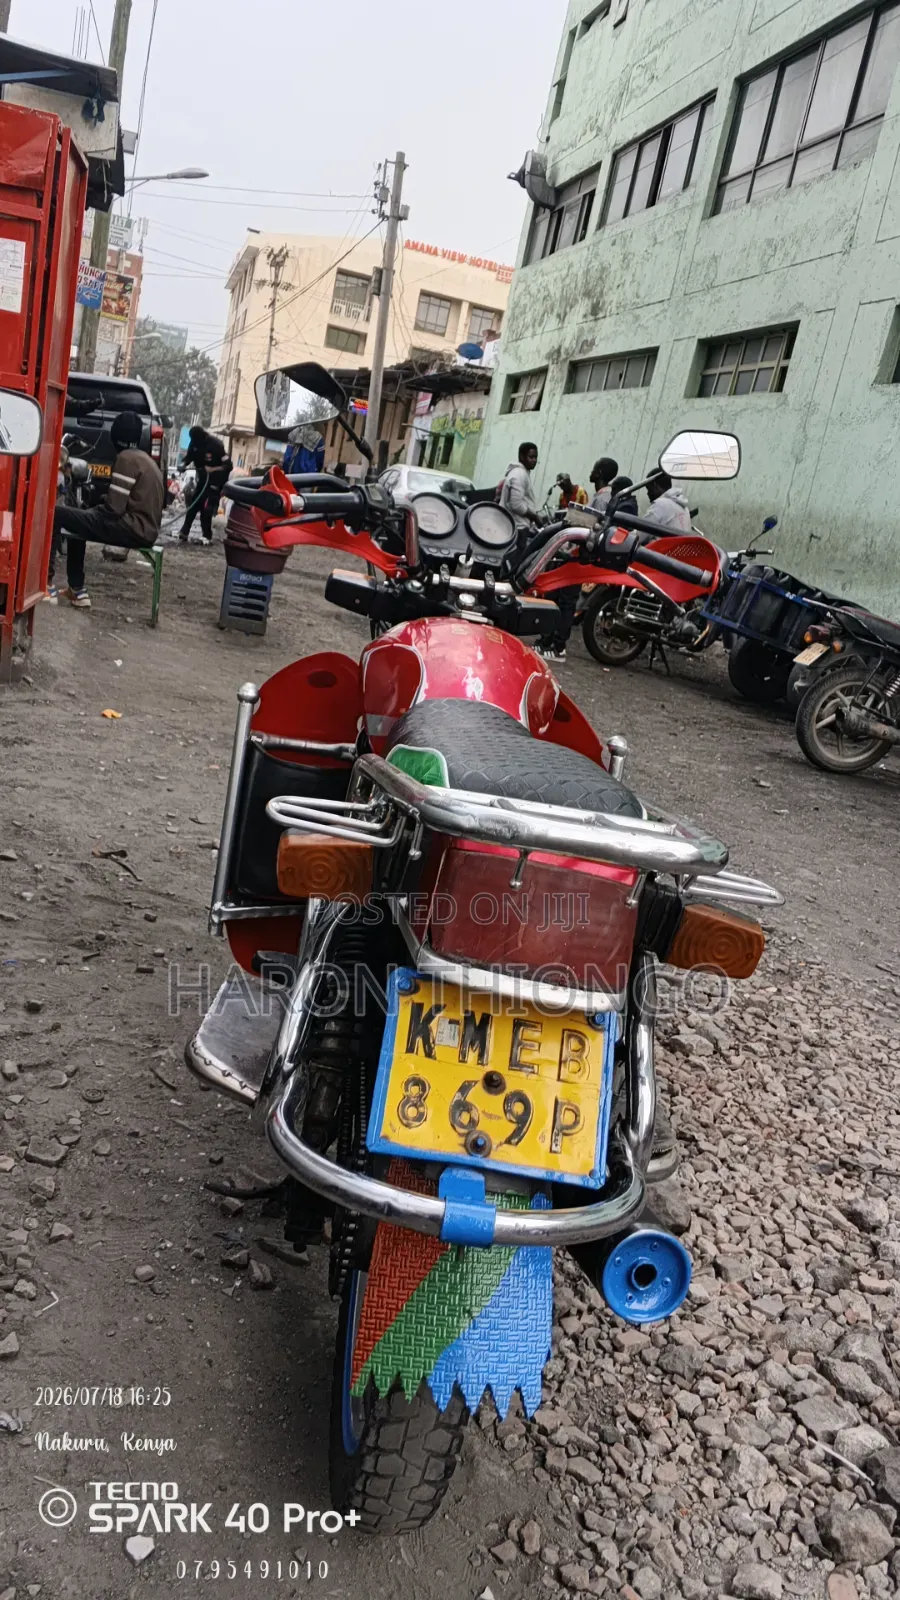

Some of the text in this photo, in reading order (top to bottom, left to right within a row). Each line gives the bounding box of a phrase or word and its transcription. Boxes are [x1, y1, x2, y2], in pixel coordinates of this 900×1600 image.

[404, 239, 439, 257] AMANA
[441, 248, 467, 264] VIEW
[405, 1001, 592, 1083] KMEB
[396, 1073, 586, 1154] 869P
